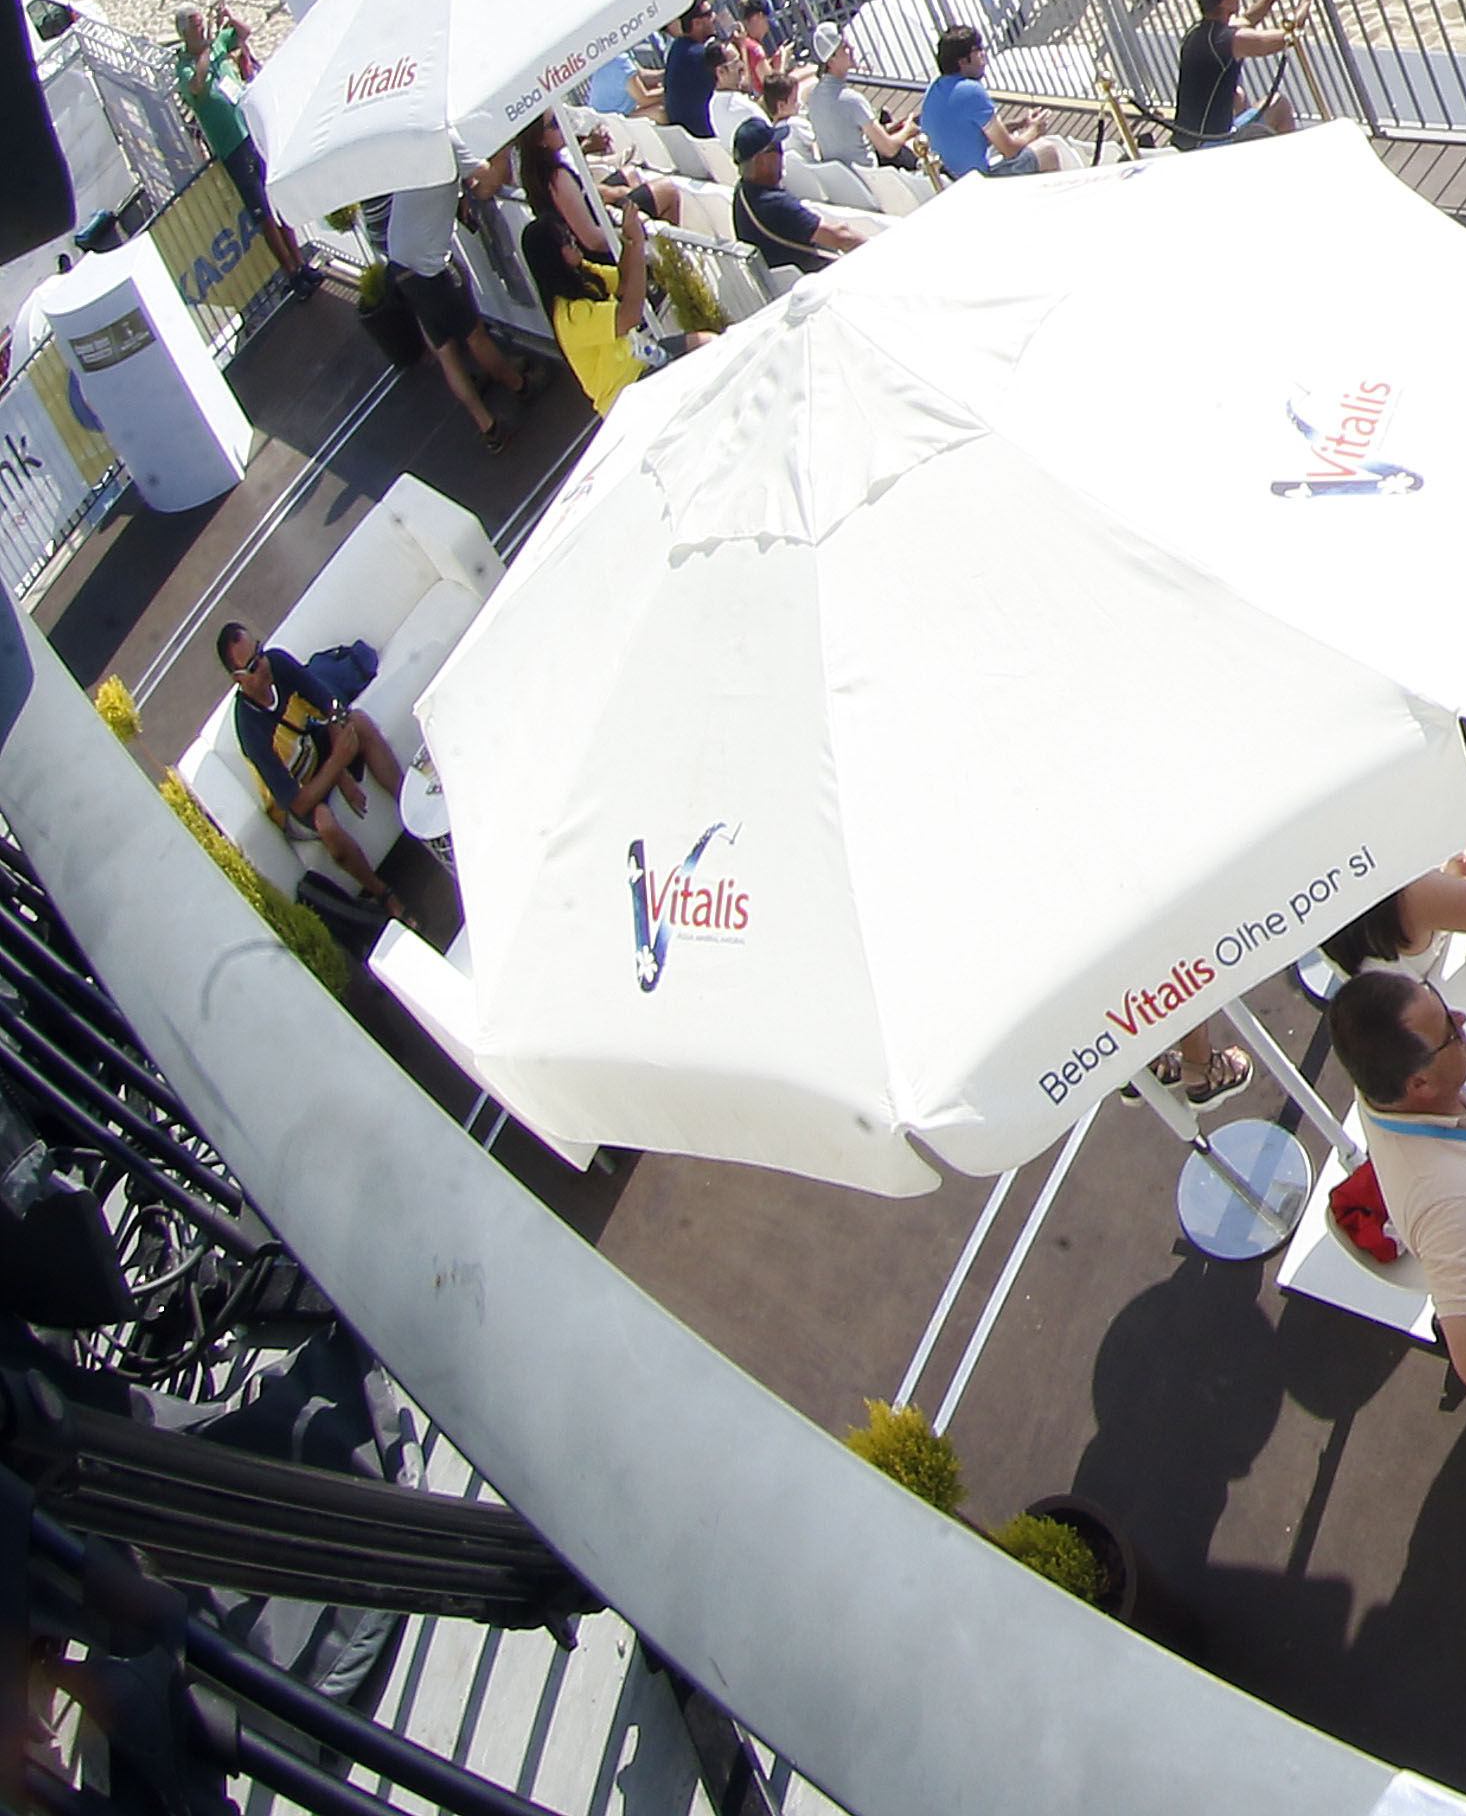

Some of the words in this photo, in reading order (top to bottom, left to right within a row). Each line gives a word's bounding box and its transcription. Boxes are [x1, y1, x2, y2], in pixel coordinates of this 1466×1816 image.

[344, 56, 419, 106] Vitalis
[504, 88, 543, 123] Beba
[538, 51, 586, 91] Vitalis
[585, 31, 619, 61] Olhe
[619, 13, 646, 41] por
[1306, 378, 1391, 484] Vitalis
[648, 856, 749, 931] Vitalis
[1037, 1030, 1122, 1108] Beba
[1105, 952, 1217, 1039] Vitalis
[1214, 901, 1291, 969] Olhe
[1289, 865, 1351, 928] por
[1346, 843, 1378, 885] si
